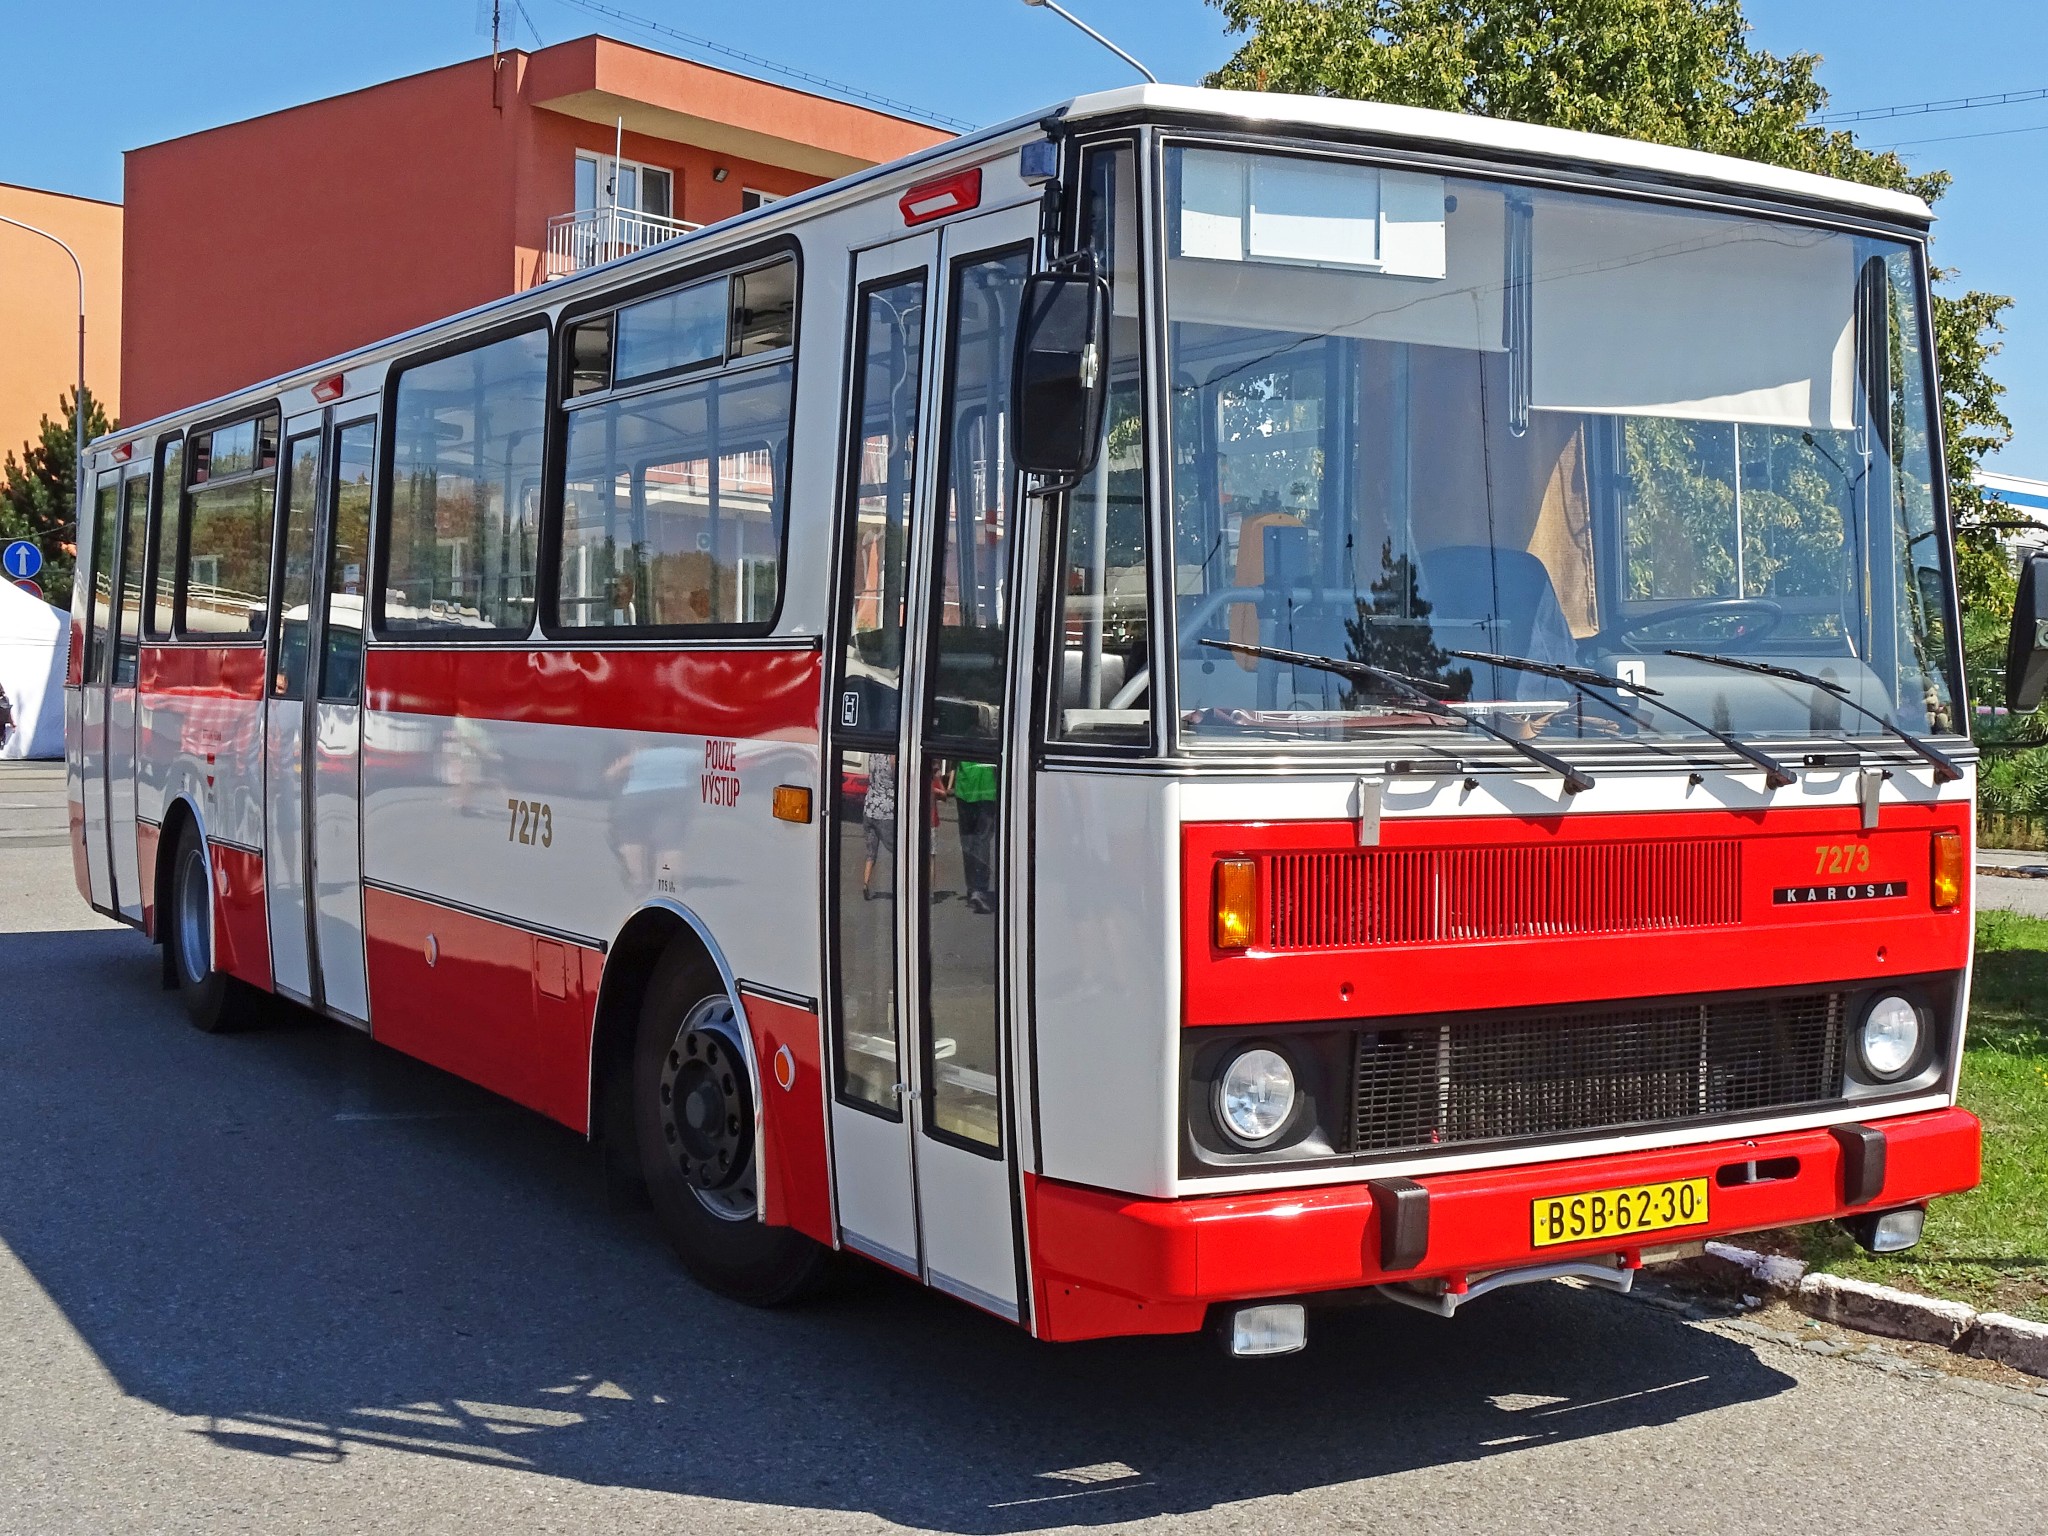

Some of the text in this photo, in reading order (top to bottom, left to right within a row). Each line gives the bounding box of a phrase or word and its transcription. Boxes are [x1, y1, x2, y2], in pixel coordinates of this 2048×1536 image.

[1625, 668, 1634, 685] 1
[705, 739, 736, 772] POUZE
[701, 771, 740, 807] VÝSTUP
[508, 798, 553, 848] 7273
[1815, 844, 1871, 875] 7273
[1787, 883, 1893, 902] KAROSA
